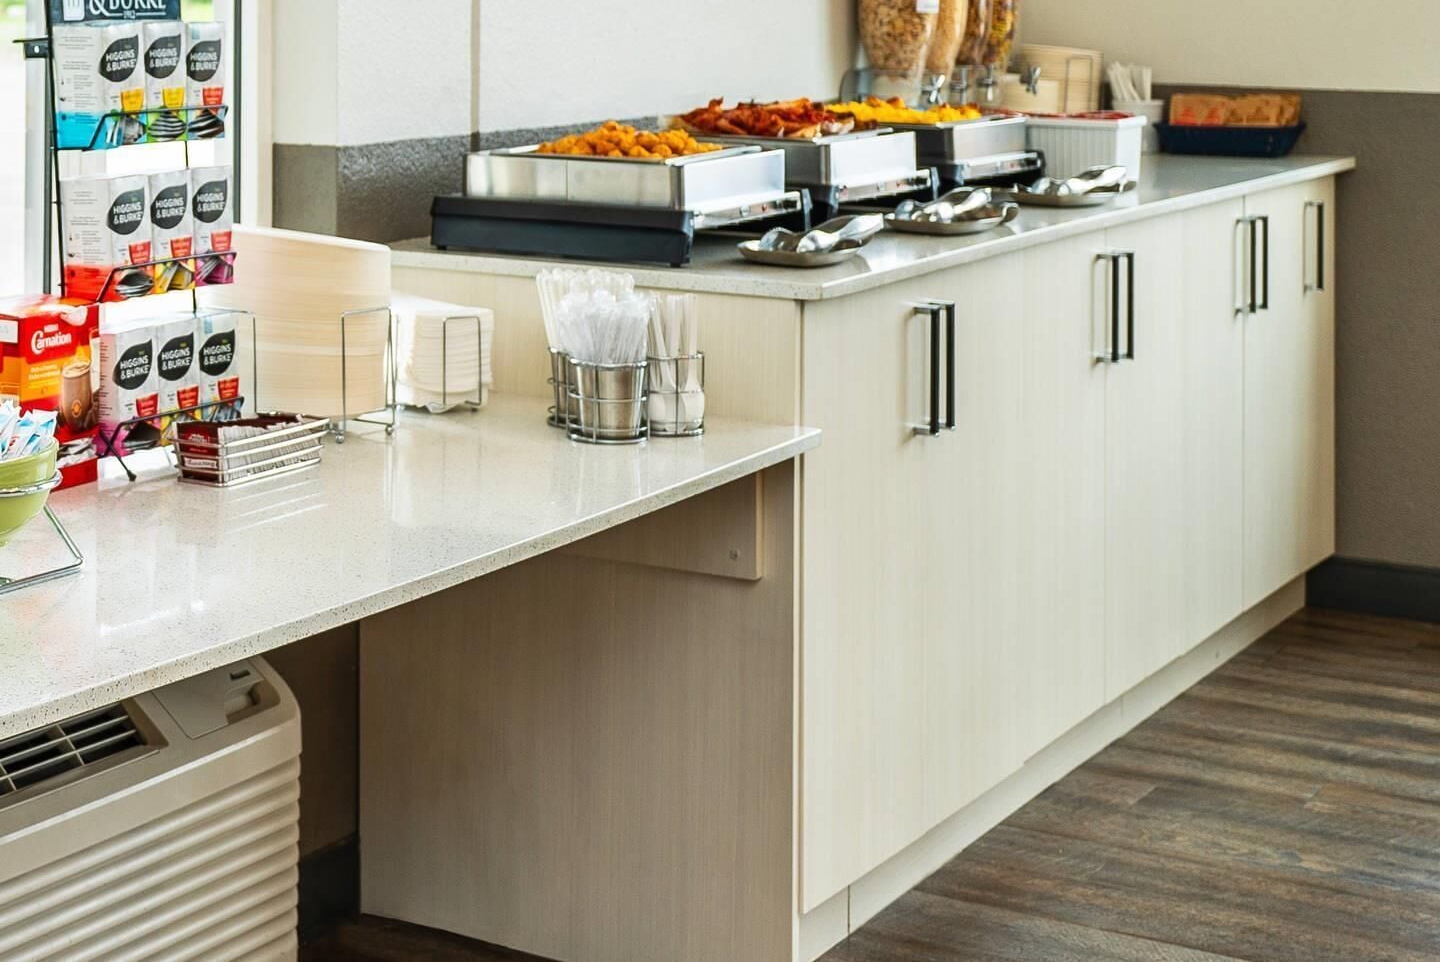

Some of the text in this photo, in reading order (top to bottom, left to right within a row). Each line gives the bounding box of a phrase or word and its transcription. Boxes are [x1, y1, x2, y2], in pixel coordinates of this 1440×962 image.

[155, 197, 185, 209] HIGGINS
[197, 192, 225, 202] HIGGINS
[113, 202, 142, 214] HIGGINS
[31, 330, 72, 355] Carnation
[161, 347, 191, 360] HIGGINS
[203, 343, 231, 355] HIGGINS
[120, 355, 149, 369] HIGGINS
